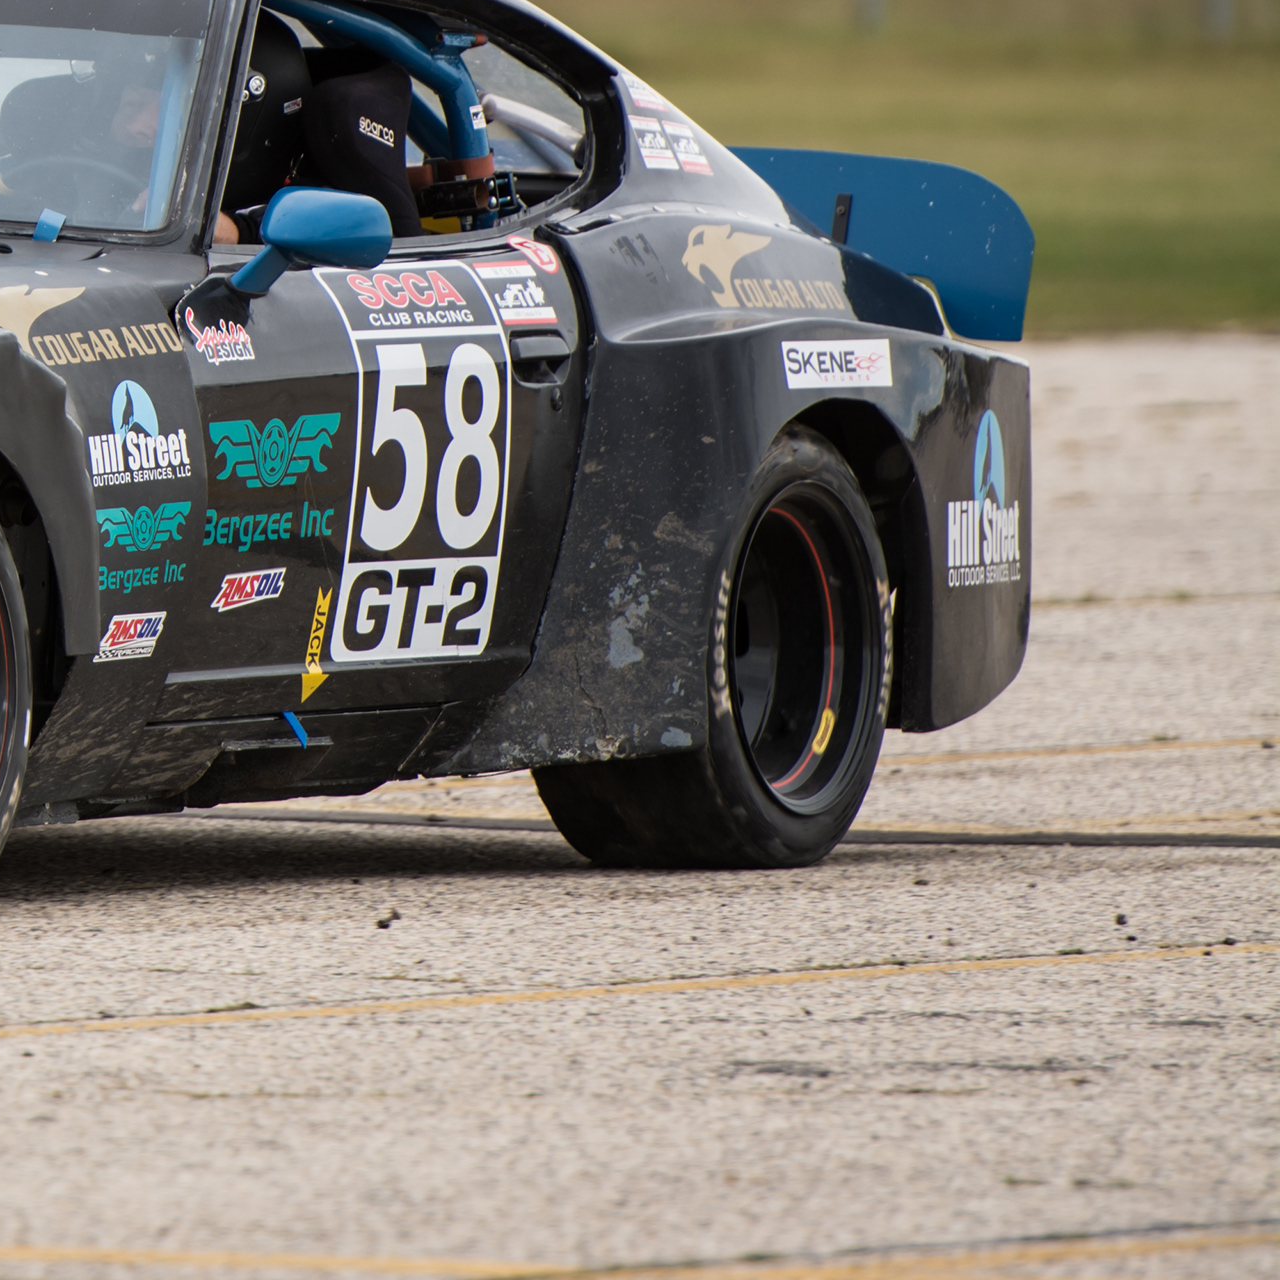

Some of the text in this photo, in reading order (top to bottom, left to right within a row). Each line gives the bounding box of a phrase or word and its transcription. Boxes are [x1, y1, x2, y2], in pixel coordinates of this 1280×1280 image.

[359, 116, 395, 144] sparco
[347, 270, 467, 309] SCCA
[733, 278, 806, 309] COUGAR
[368, 309, 475, 326] CLUB RACING
[32, 322, 184, 366] COUGAR AUTO
[203, 341, 255, 361] DESIGN
[786, 348, 858, 379] SKENE
[823, 374, 870, 383] STUNTS
[88, 428, 190, 475] Hill Street
[360, 343, 500, 551] 58
[92, 465, 192, 487] OUTDOOR SERVICES, LLC
[300, 501, 335, 538] Inc
[947, 497, 1020, 568] Hill Street
[163, 559, 187, 583] Inc
[948, 566, 986, 588] OUTDOOR
[215, 571, 284, 609] AMSOIL
[342, 565, 489, 652] GT-2
[103, 616, 163, 648] AMSOIL
[307, 604, 327, 668] JACK
[114, 646, 153, 658] RACING
